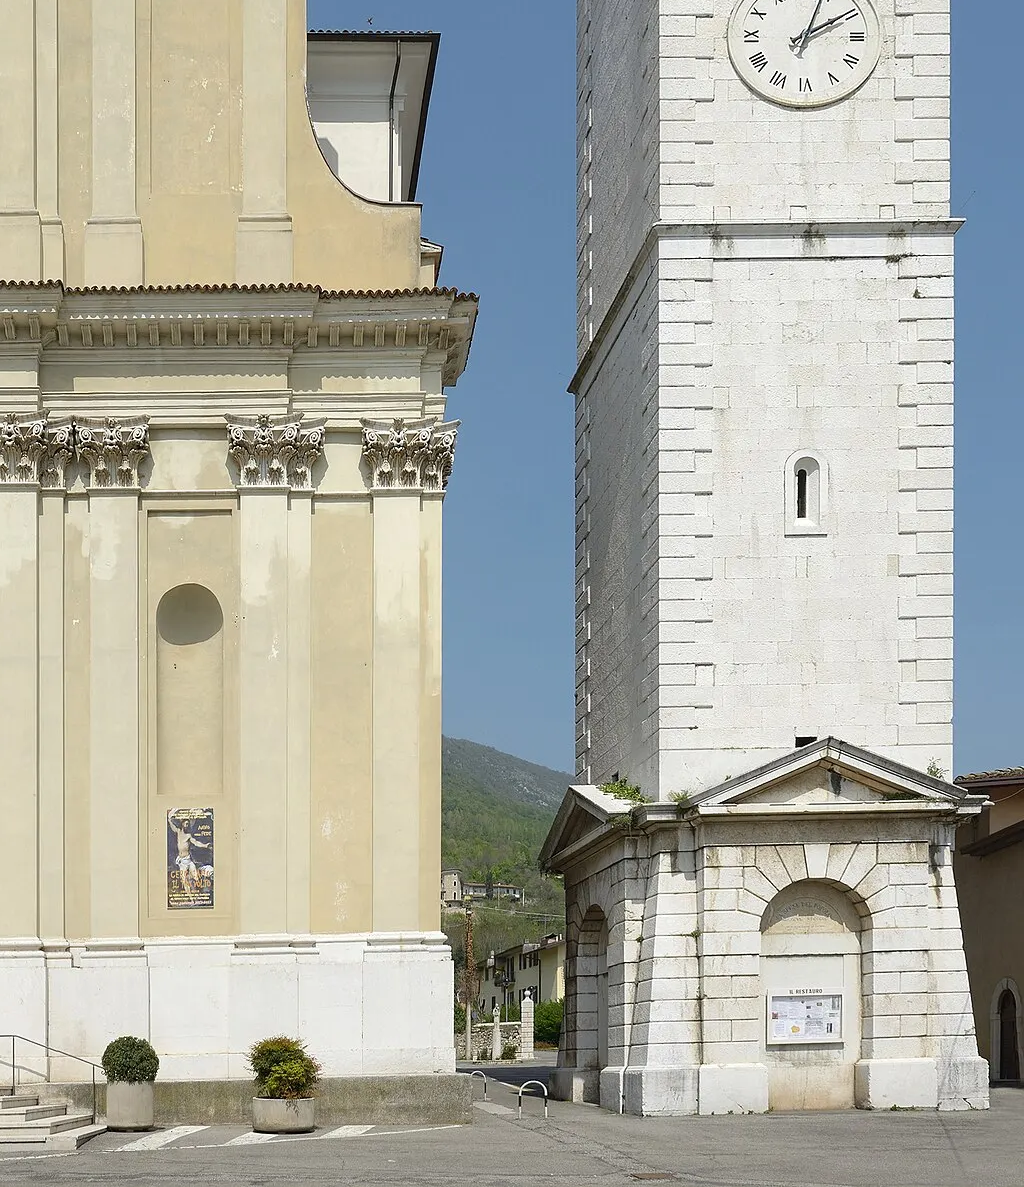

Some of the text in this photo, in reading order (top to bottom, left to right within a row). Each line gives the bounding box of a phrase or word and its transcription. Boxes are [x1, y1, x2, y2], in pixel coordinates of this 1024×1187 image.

[750, 7, 767, 20] X
[743, 29, 759, 43] IX
[849, 31, 864, 42] III
[749, 52, 768, 73] VIII
[843, 53, 859, 69] IV
[769, 70, 787, 89] VII
[799, 77, 812, 92] VI
[828, 71, 839, 86] V
